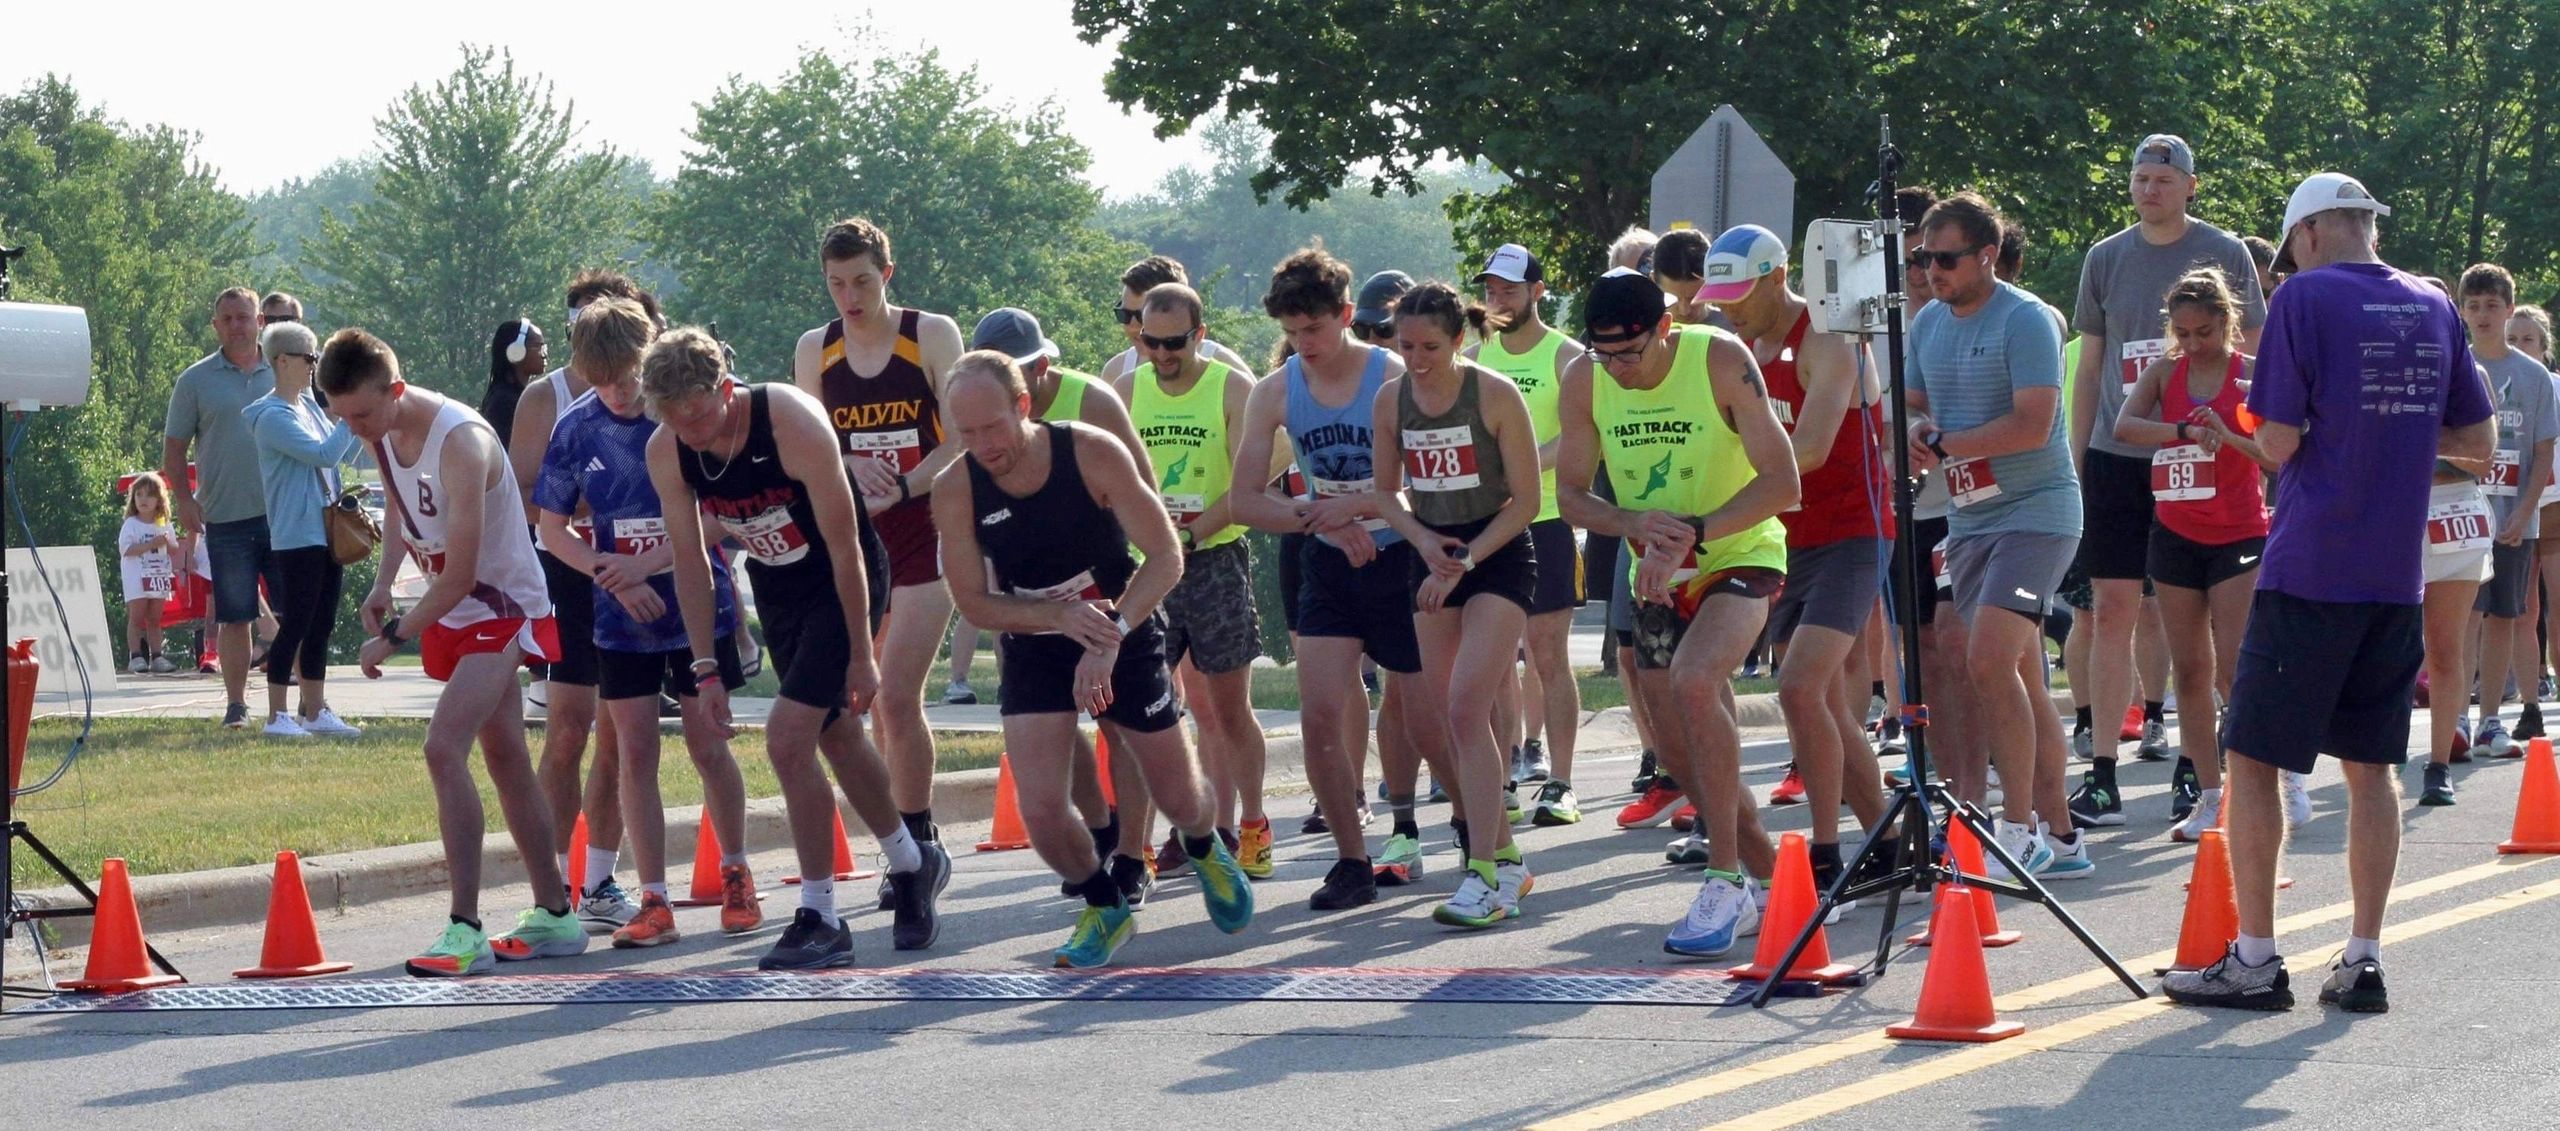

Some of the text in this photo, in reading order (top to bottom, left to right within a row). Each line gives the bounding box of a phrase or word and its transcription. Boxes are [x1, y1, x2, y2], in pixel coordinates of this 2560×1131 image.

[1512, 377, 1538, 387] RACK
[833, 399, 922, 429] CALVIN
[1140, 425, 1208, 439] FAST TRACK
[1297, 423, 1374, 456] MEDINA
[1614, 421, 1693, 438] FAST TRACK
[1621, 437, 1686, 448] RACING TEAM
[1146, 438, 1201, 448] RACING TEAM
[1415, 448, 1461, 478] 128
[2169, 462, 2194, 488] 69
[1950, 464, 1975, 494] 25
[417, 479, 437, 517] B
[2440, 515, 2480, 542] 100
[149, 577, 172, 591] 403
